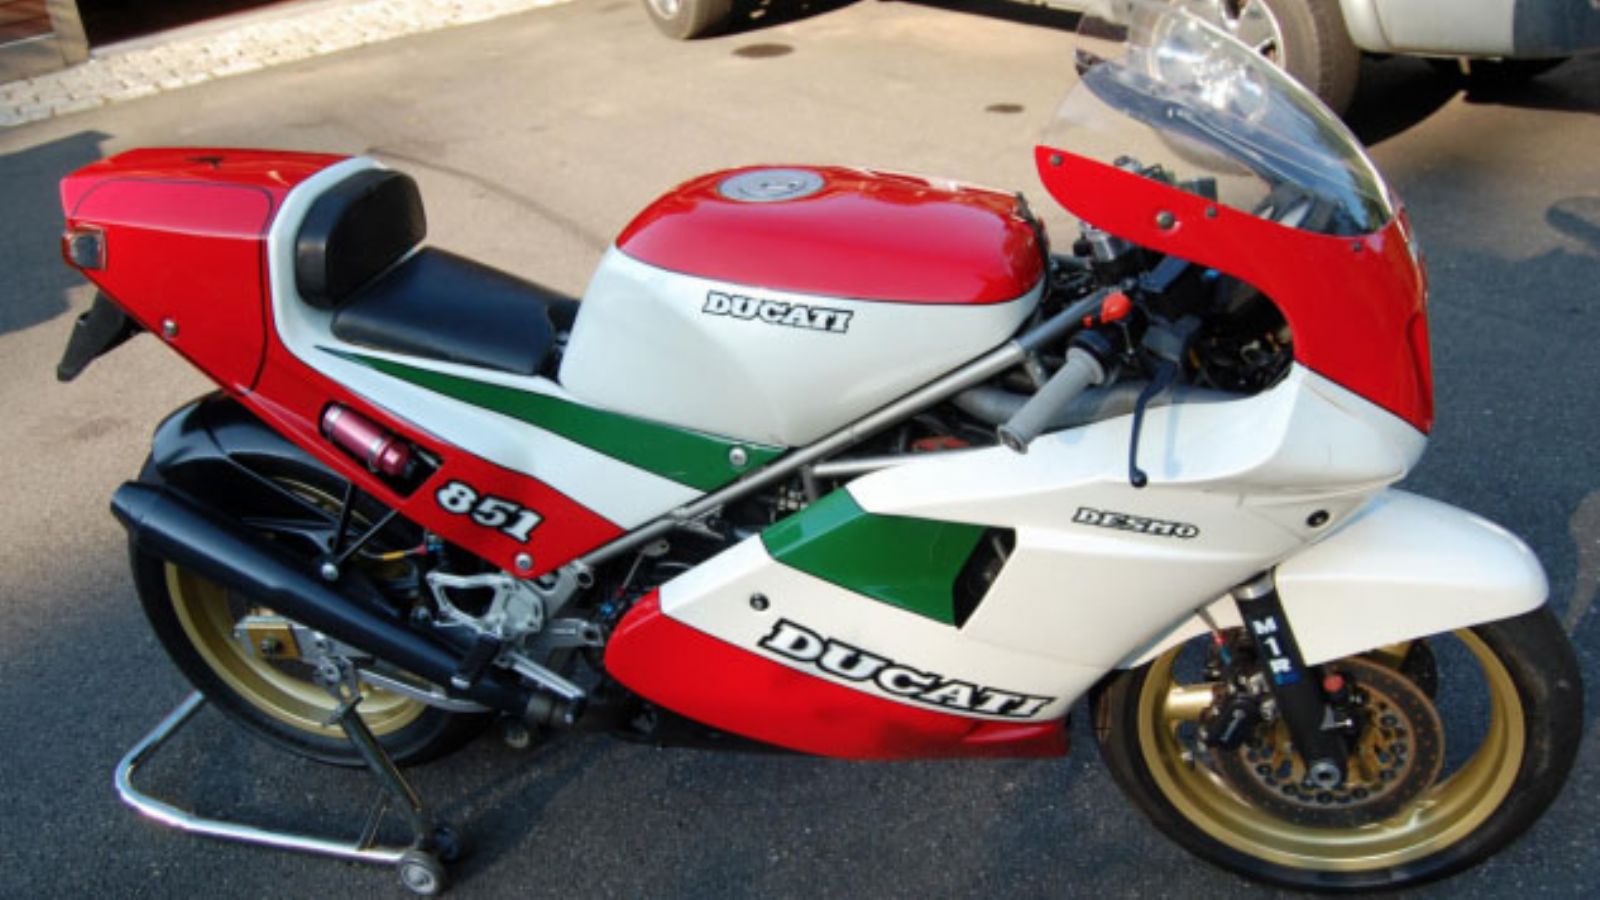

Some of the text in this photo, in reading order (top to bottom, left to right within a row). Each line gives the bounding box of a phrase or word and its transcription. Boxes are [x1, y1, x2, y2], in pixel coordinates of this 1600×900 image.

[702, 290, 854, 333] DUCATI
[435, 479, 545, 544] 851
[1072, 507, 1199, 538] DESMO
[757, 617, 1057, 718] DUCATI
